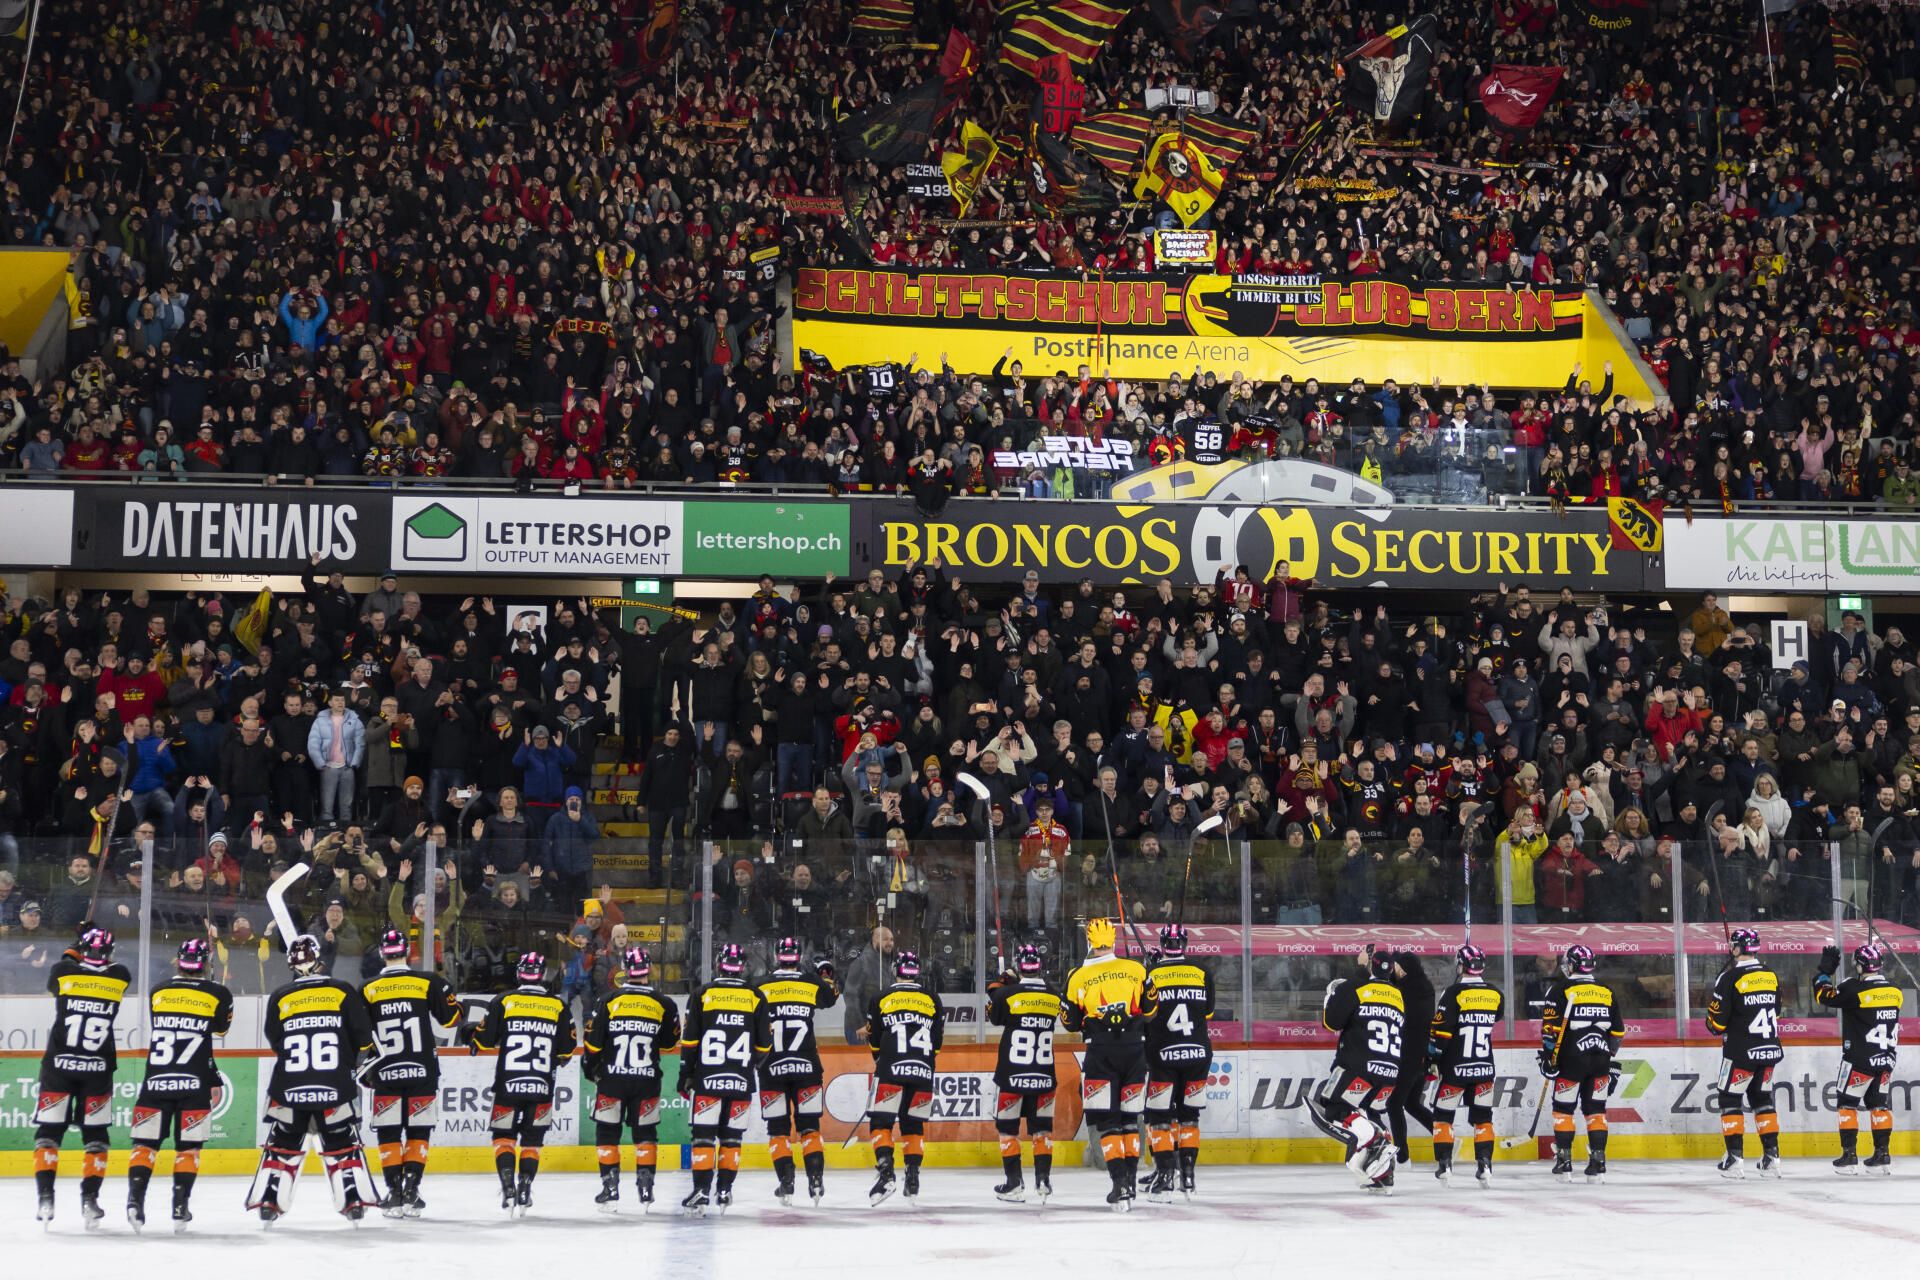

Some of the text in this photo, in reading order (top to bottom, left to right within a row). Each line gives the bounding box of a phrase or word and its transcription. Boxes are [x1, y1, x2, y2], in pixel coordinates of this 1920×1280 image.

[1588, 14, 1632, 30] Bernois
[796, 268, 1168, 325] SCHLITTSCHUH
[1424, 288, 1555, 332] BERN
[1236, 292, 1281, 304] IMMER
[1285, 293, 1300, 304] BI
[1034, 337, 1249, 362] PostFinance Arena
[869, 371, 894, 388] 10
[1194, 432, 1222, 450] 58
[122, 501, 358, 561] DATENHAUS
[485, 521, 671, 548] LETTERSHOP
[696, 531, 841, 554] lettershop.ch
[485, 550, 671, 566] OUTPUT MANAGEMENT
[884, 518, 1181, 576] BRONCOS
[1331, 521, 1613, 578] SECURITY
[1232, 582, 1254, 600] 10
[1778, 626, 1803, 658] H
[1364, 788, 1378, 798] 33
[1276, 944, 1316, 952] TimeTool
[1386, 944, 1426, 952] TimeTool
[1602, 942, 1640, 952] TimeTool
[1768, 942, 1804, 950] TimeTool
[1176, 988, 1206, 1001] AKTELL
[380, 1002, 412, 1016] RHYN
[716, 1014, 744, 1026] ALGE
[777, 1006, 810, 1017] MOSER
[883, 1012, 933, 1029] FÜLLEMANN
[1167, 1004, 1194, 1036] 4
[1574, 1006, 1610, 1016] LOEFFEL
[1876, 1010, 1897, 1020] KREIS
[64, 1014, 110, 1052] 19
[508, 1020, 556, 1036] LEHMANN
[609, 1018, 661, 1035] SCHERWEY
[1277, 1027, 1316, 1036] TimeTool
[1748, 1008, 1777, 1039] 41
[150, 1030, 204, 1066] 37
[377, 1016, 422, 1056] 51
[772, 1020, 808, 1052] 17
[891, 1023, 933, 1056] 14
[1009, 1030, 1054, 1065] 88
[1368, 1020, 1402, 1056] 33
[1459, 1026, 1492, 1058] 15
[1866, 1024, 1898, 1050] 44
[284, 1032, 339, 1072] 36
[505, 1034, 552, 1072] 23
[614, 1034, 653, 1068] 10
[702, 1030, 752, 1068] 64
